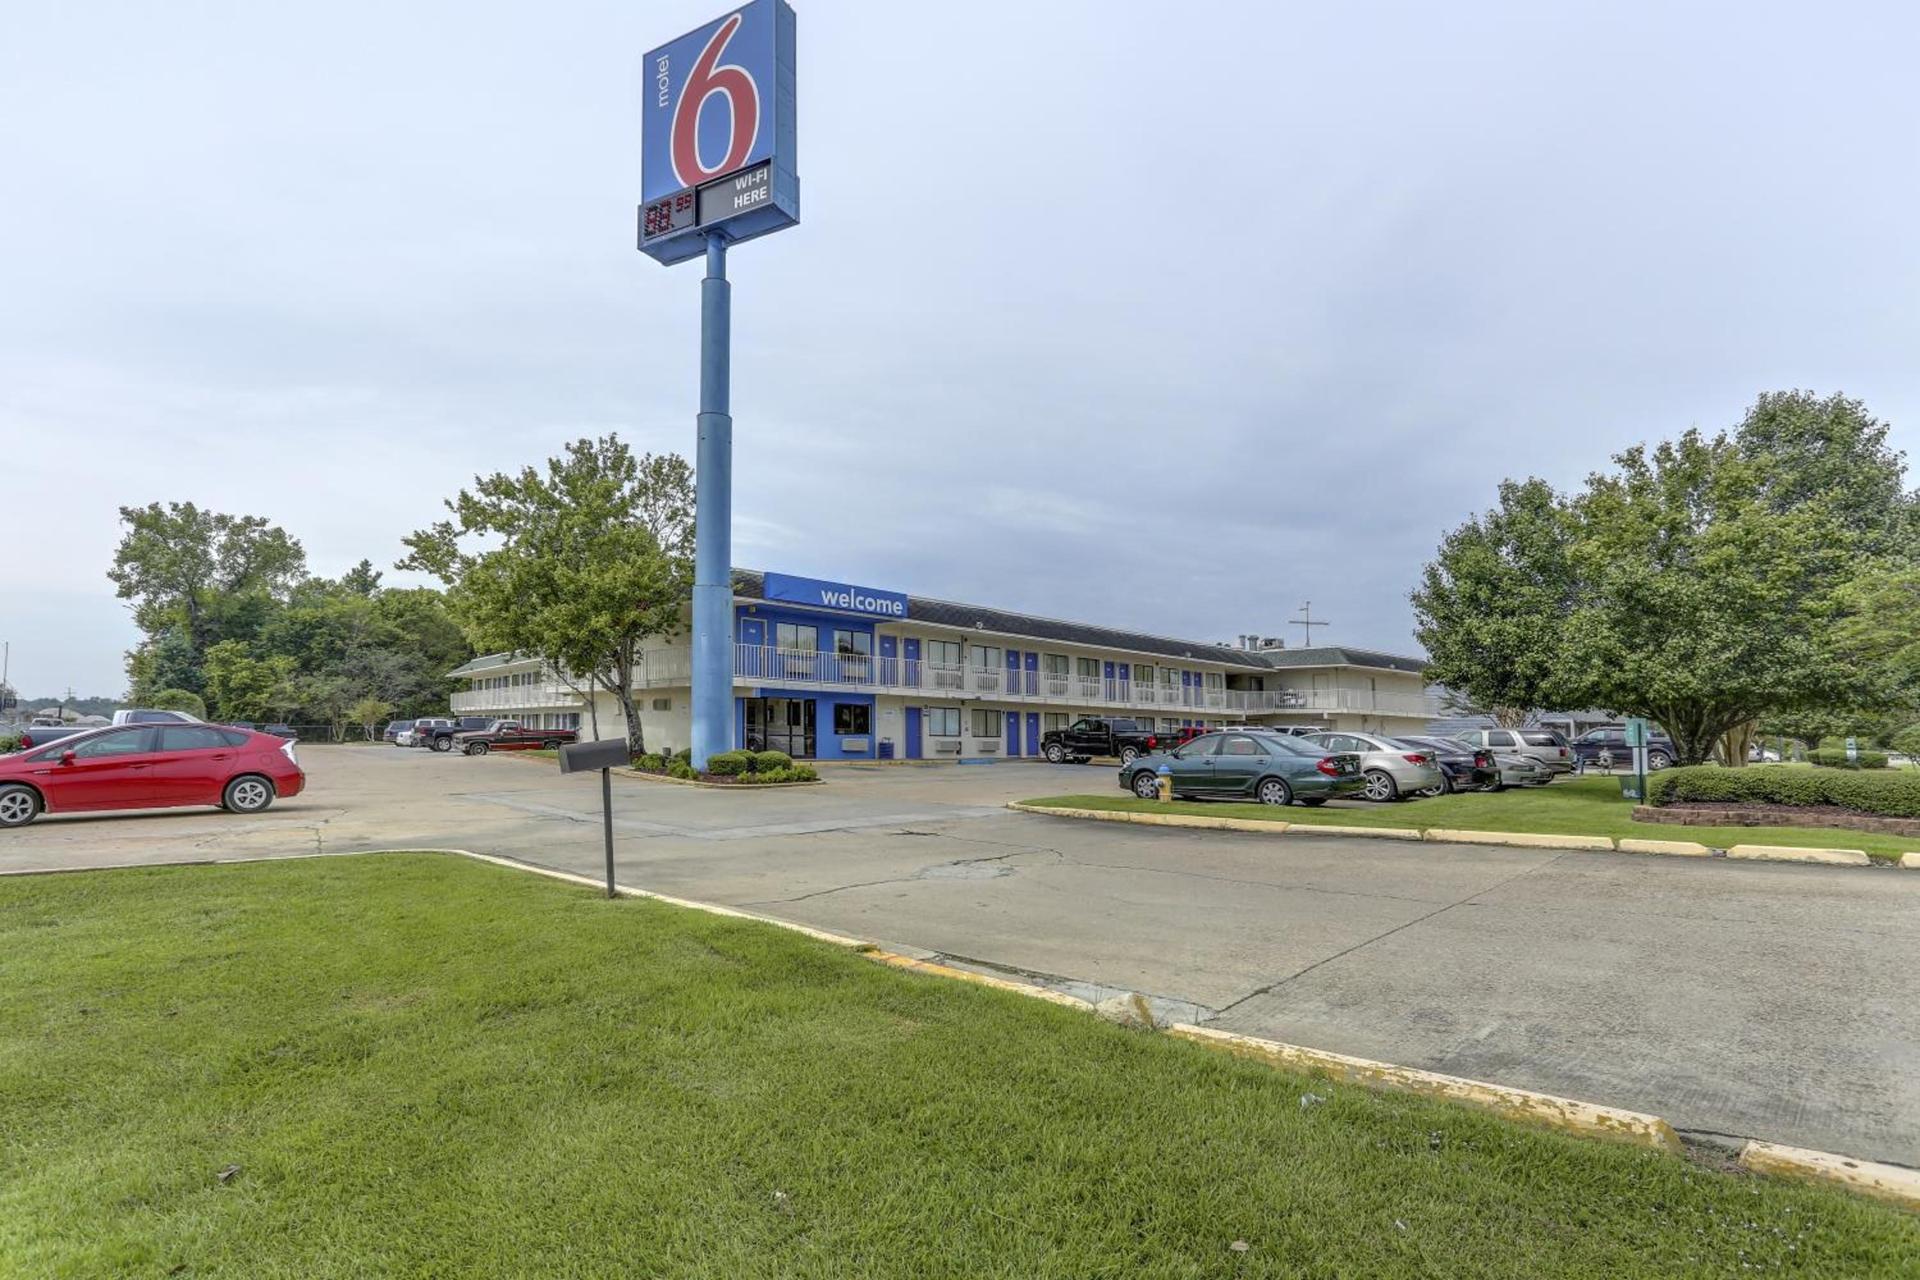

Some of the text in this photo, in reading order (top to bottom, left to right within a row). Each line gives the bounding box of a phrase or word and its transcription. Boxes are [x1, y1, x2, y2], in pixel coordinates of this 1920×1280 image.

[656, 12, 760, 188] motel 6
[735, 168, 767, 190] WI-FI
[734, 186, 767, 209] HERE
[821, 588, 903, 615] welcome
